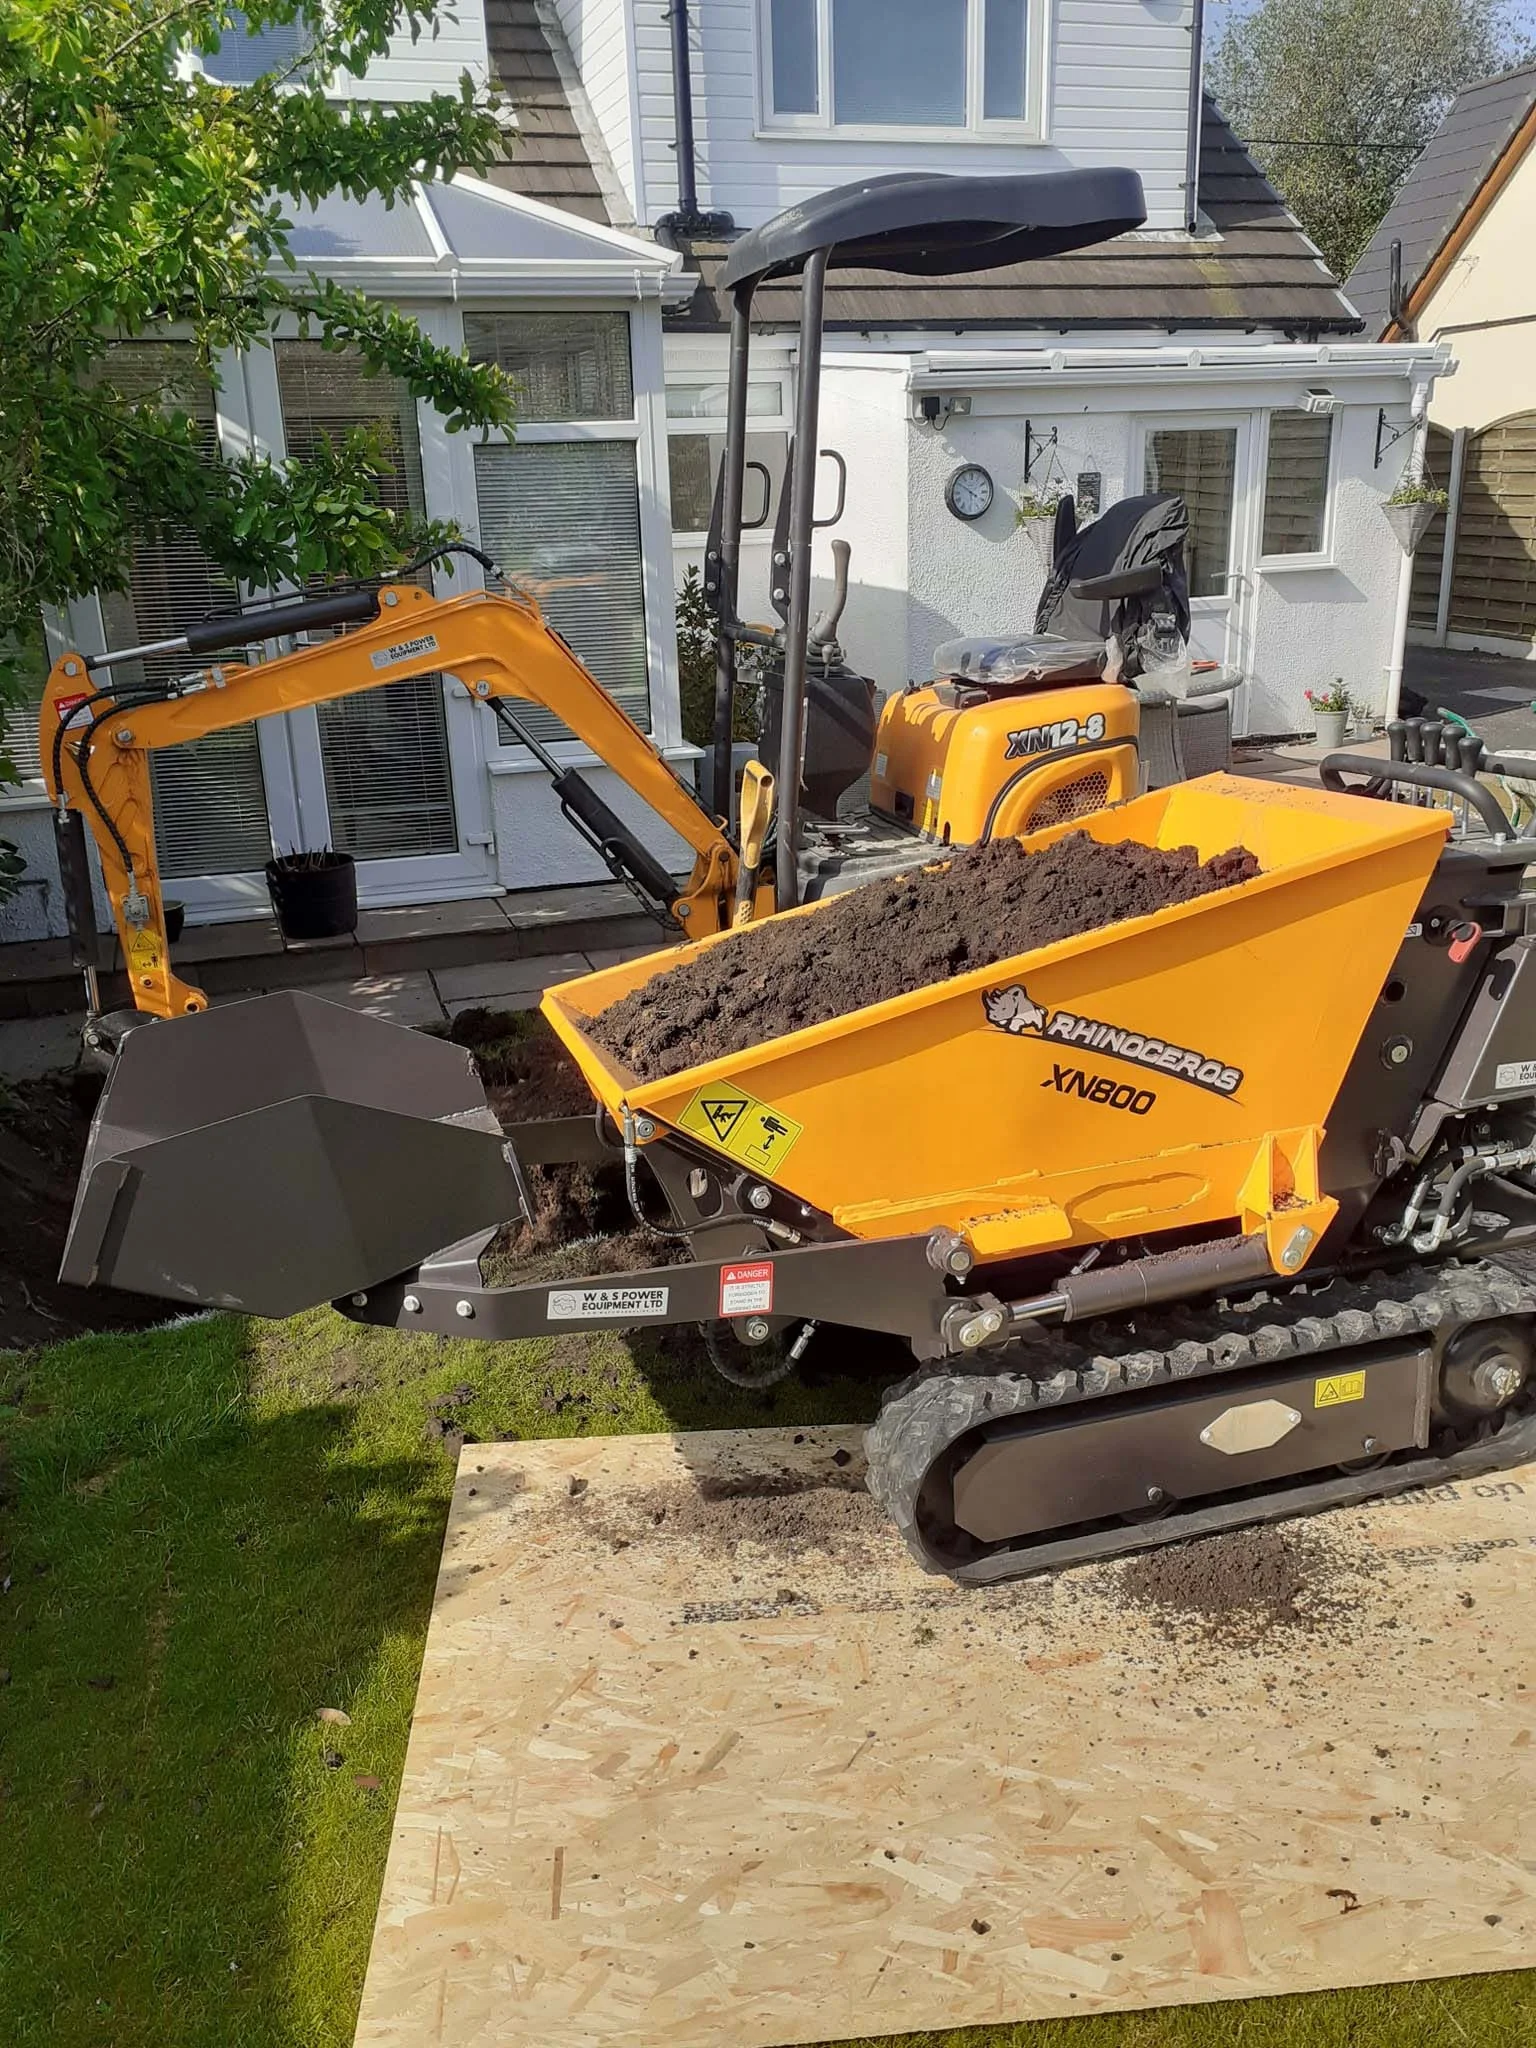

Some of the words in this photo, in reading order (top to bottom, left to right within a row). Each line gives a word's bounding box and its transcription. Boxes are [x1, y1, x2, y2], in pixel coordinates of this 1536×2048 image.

[410, 635, 434, 647] POWER
[390, 645, 424, 659] EQUIPMENT
[425, 641, 436, 649] LTD
[1005, 713, 1105, 759] XN12-8
[1048, 1012, 1243, 1092] RHINOCEROS
[1040, 1064, 1156, 1115] XN800
[737, 1269, 769, 1280] DANGER
[584, 1293, 597, 1301] W
[601, 1292, 609, 1301] &
[612, 1291, 619, 1300] S
[622, 1291, 664, 1300] POWER
[582, 1300, 641, 1310] EQUIPMENT
[644, 1300, 663, 1309] LTD
